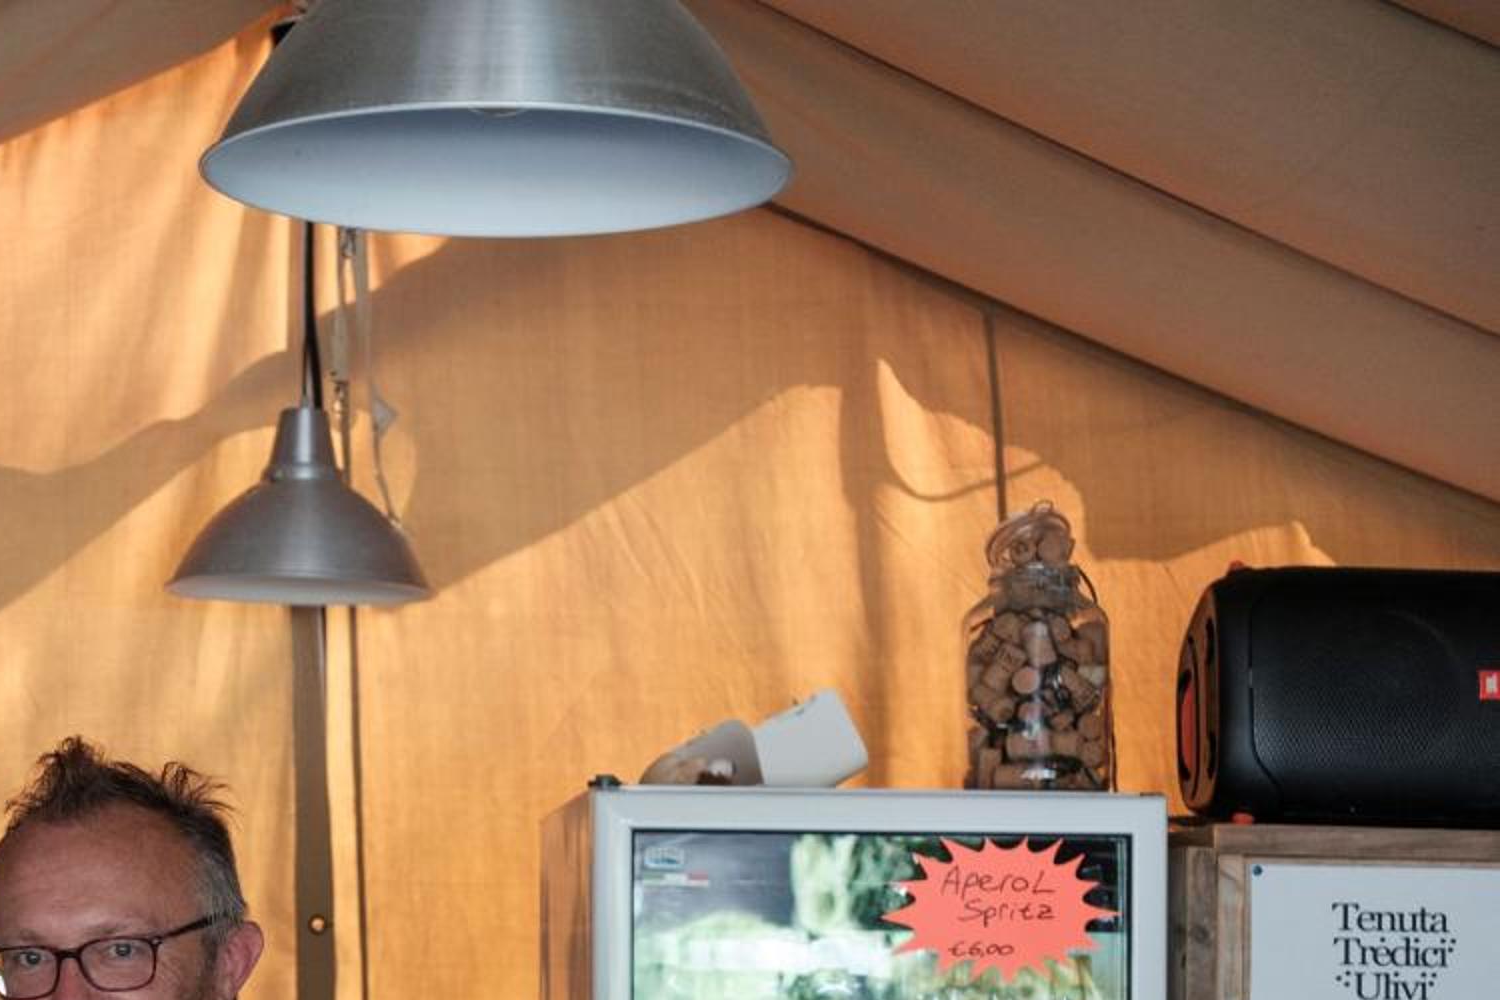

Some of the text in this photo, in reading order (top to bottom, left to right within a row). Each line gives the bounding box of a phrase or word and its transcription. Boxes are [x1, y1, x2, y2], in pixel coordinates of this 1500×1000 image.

[957, 900, 1055, 928] Spritz
[1332, 902, 1449, 933] Tenuta
[1333, 936, 1452, 967] Tredici
[1355, 972, 1430, 1000] Ulivi
